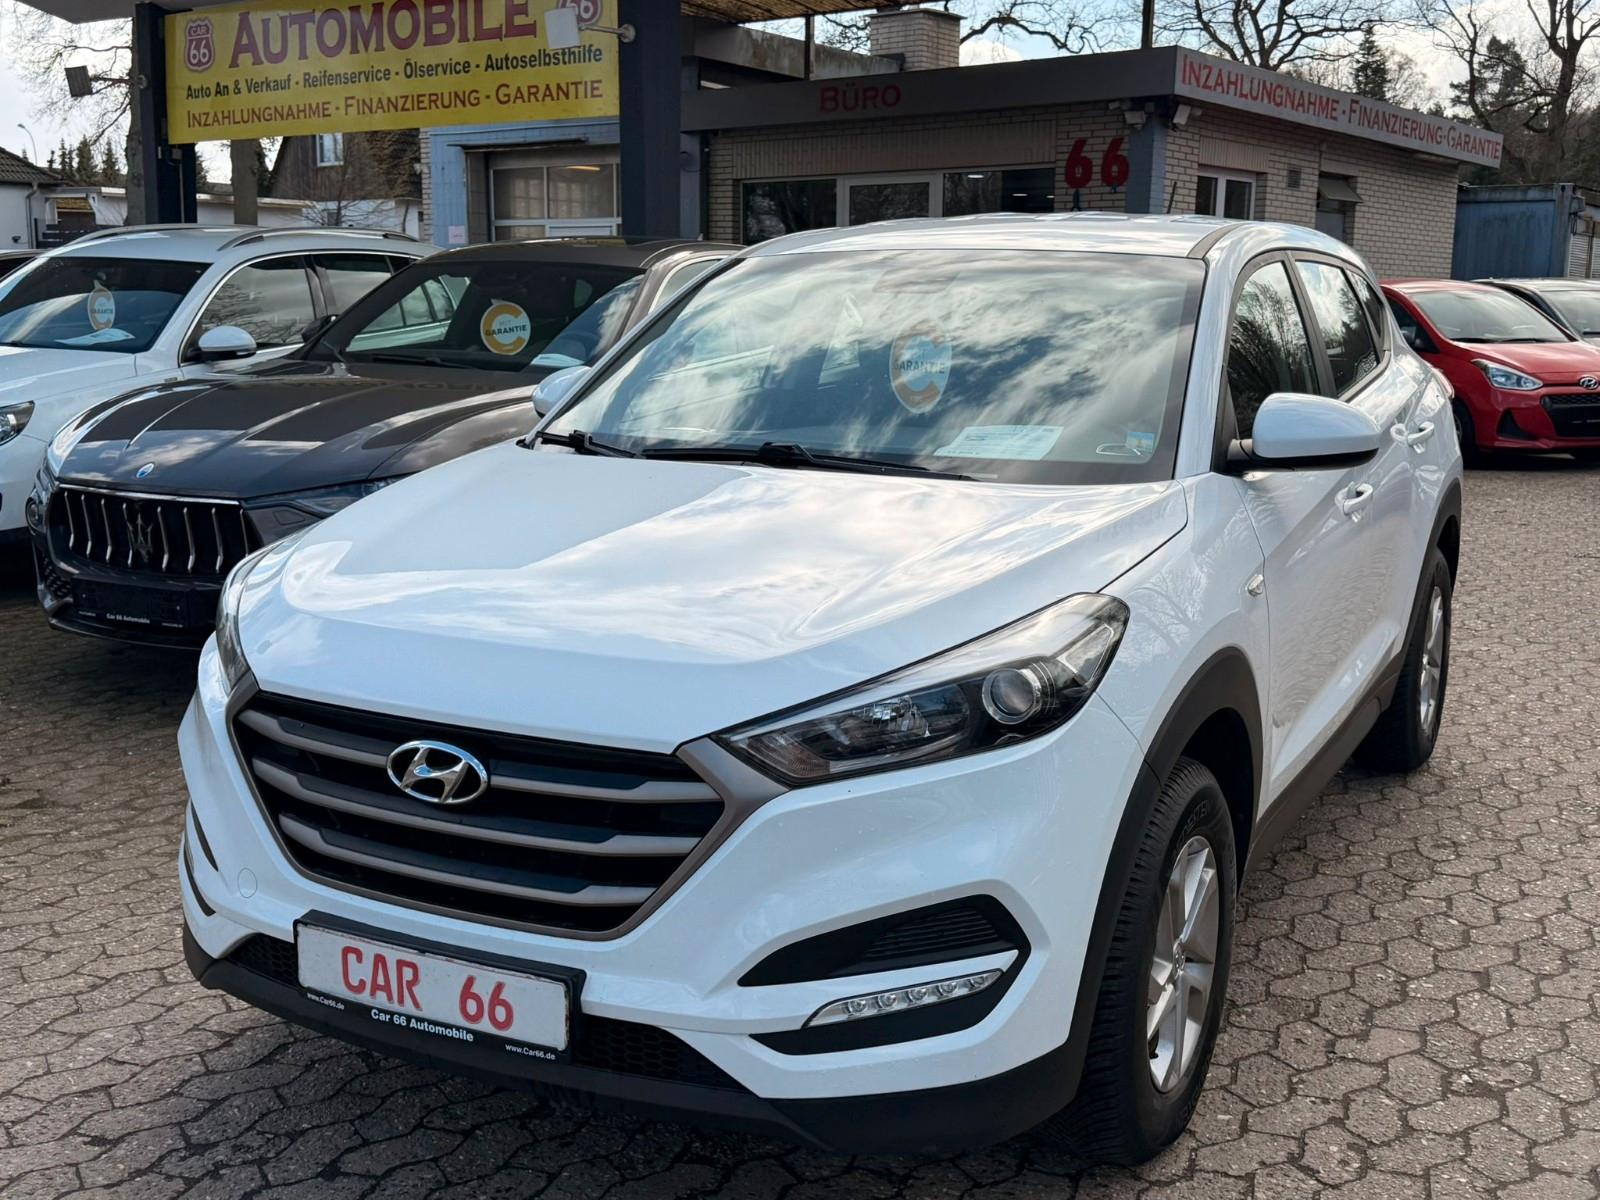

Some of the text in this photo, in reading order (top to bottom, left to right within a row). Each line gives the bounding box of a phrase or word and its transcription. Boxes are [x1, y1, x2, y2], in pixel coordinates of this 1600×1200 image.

[189, 25, 209, 36] CAR
[228, 0, 537, 68] AUTOMOBILE
[186, 43, 602, 100] Auto An & Verkauf Reifenservice Ölservice Autoselbsthilfe
[190, 39, 209, 64] 66
[187, 79, 603, 128] INZAHLUNGNAHME FINANZIERUNG GARANTIE
[820, 81, 902, 112] BÜRO
[1181, 54, 1502, 160] INZAHLUNGNAHME FINANZIERUNG GARANTIE
[1064, 136, 1130, 189] 66
[485, 324, 527, 337] GARANTIE
[341, 945, 514, 1032] CAR 66
[371, 1008, 474, 1042] Car 66 Automobile
[505, 1044, 556, 1060] www.Car66.de
